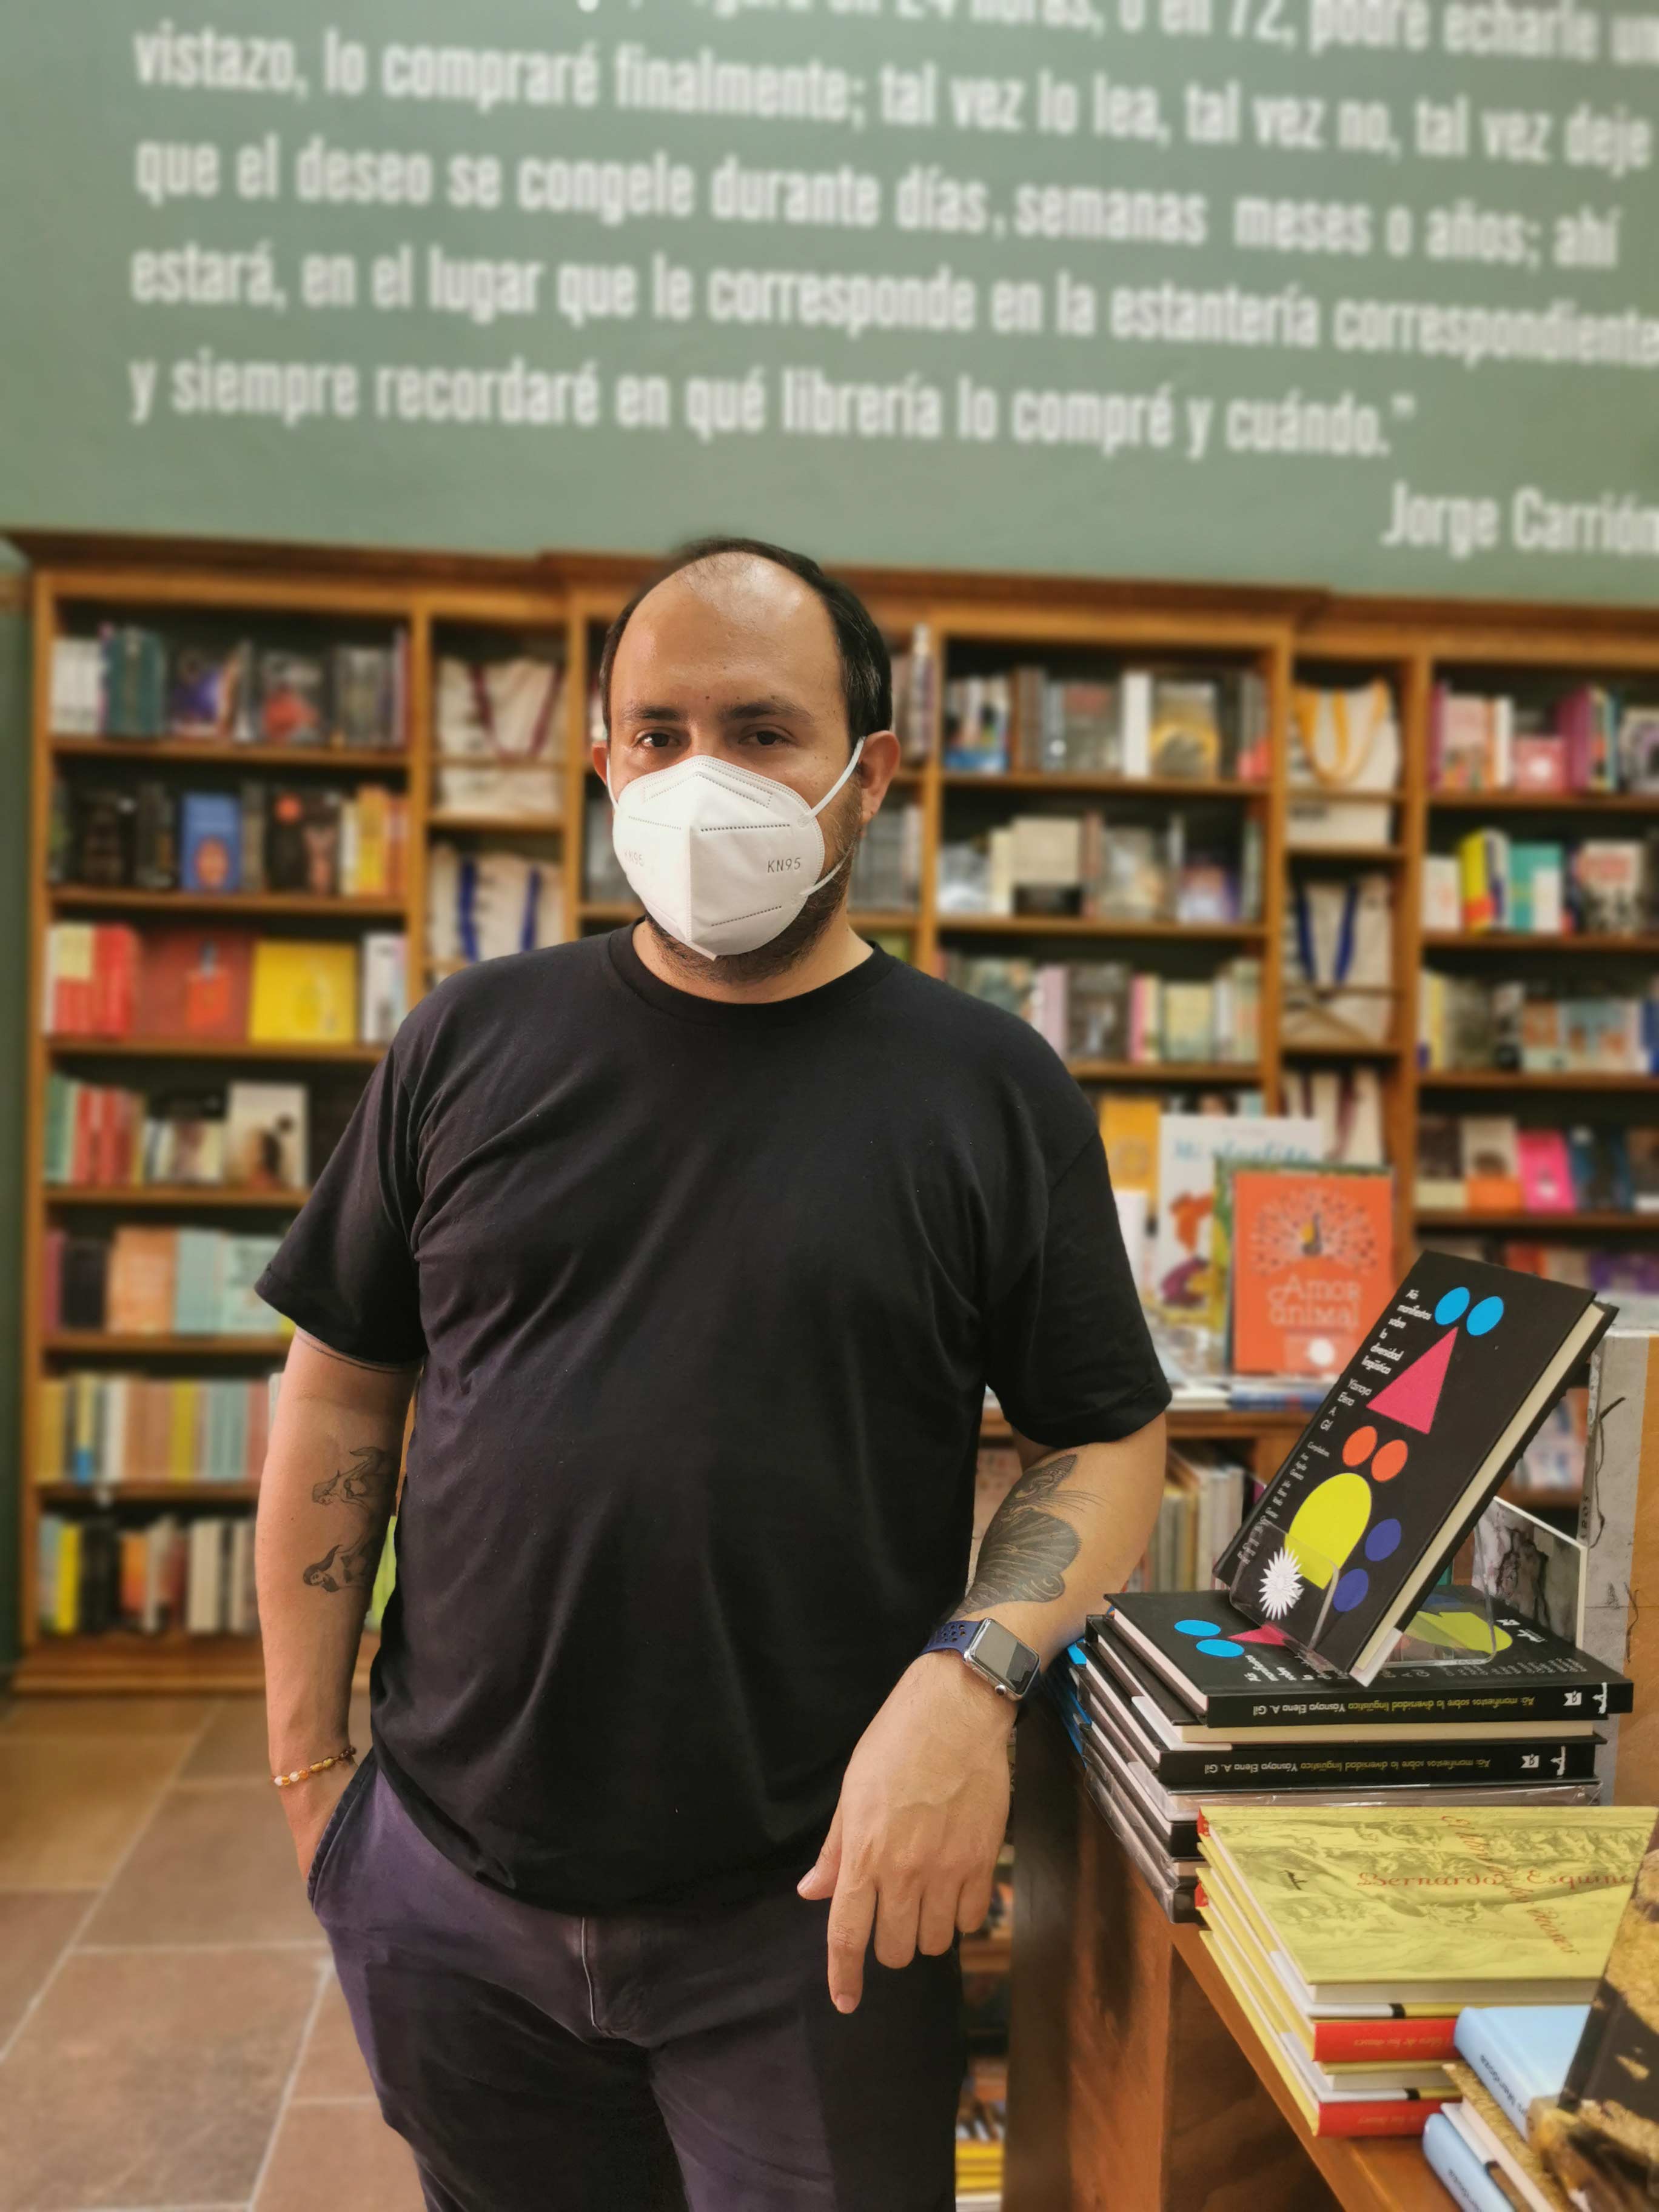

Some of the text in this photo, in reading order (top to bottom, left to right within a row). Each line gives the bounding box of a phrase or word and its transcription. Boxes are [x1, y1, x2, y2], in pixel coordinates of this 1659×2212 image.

[132, 19, 1653, 179] vistazo, lo compraré finalmente; tal vez lo lea, tal vez no, tal vez deje
[134, 133, 1622, 270] que el deseo se congele durante días, semanas meses o años; ahí
[129, 241, 288, 309] estará,
[301, 253, 357, 309] en
[371, 244, 414, 309] el
[428, 247, 544, 326] lugar
[557, 263, 638, 327] que
[652, 253, 692, 321] le
[708, 267, 977, 338] corresponde
[990, 280, 1044, 333] en
[1056, 271, 1098, 337] la
[1110, 281, 1321, 349] estantería
[127, 360, 158, 425] y
[170, 348, 360, 427] siempre
[374, 357, 601, 428] recordaré
[614, 374, 672, 429] en
[683, 366, 768, 443] qué
[780, 366, 943, 441] librería
[956, 375, 1000, 443] lo
[1010, 384, 1176, 458] compré
[1186, 398, 1215, 461] y
[1380, 479, 1659, 561] Jorge Carrión
[767, 857, 801, 873] KN95
[1397, 1305, 1432, 1321] manifiestos
[1388, 1316, 1407, 1329] sobre
[1370, 1342, 1404, 1361] diversidad
[1337, 1392, 1355, 1406] Elena
[1320, 1419, 1334, 1431] Gil
[1276, 1667, 1297, 1681] sobre
[1269, 1704, 1281, 1714] A.
[1282, 1703, 1307, 1715] Elena
[1309, 1701, 1346, 1713] Yásnaya
[1392, 1700, 1435, 1712] diversidad
[1436, 1700, 1446, 1710] la
[1447, 1699, 1470, 1710] sobre
[1472, 1697, 1518, 1709] manifiestos
[1252, 1705, 1267, 1716] Gil
[1204, 1764, 1218, 1774] Gil
[1221, 1764, 1232, 1772] A.
[1234, 1763, 1259, 1774] Elena
[1261, 1761, 1298, 1772] Yásnaya
[1345, 1761, 1388, 1772] diversidad
[1390, 1760, 1399, 1770] la
[1401, 1760, 1424, 1770] sobre
[1427, 1759, 1473, 1770] manifiestos
[1356, 1871, 1498, 1886] Bernardo
